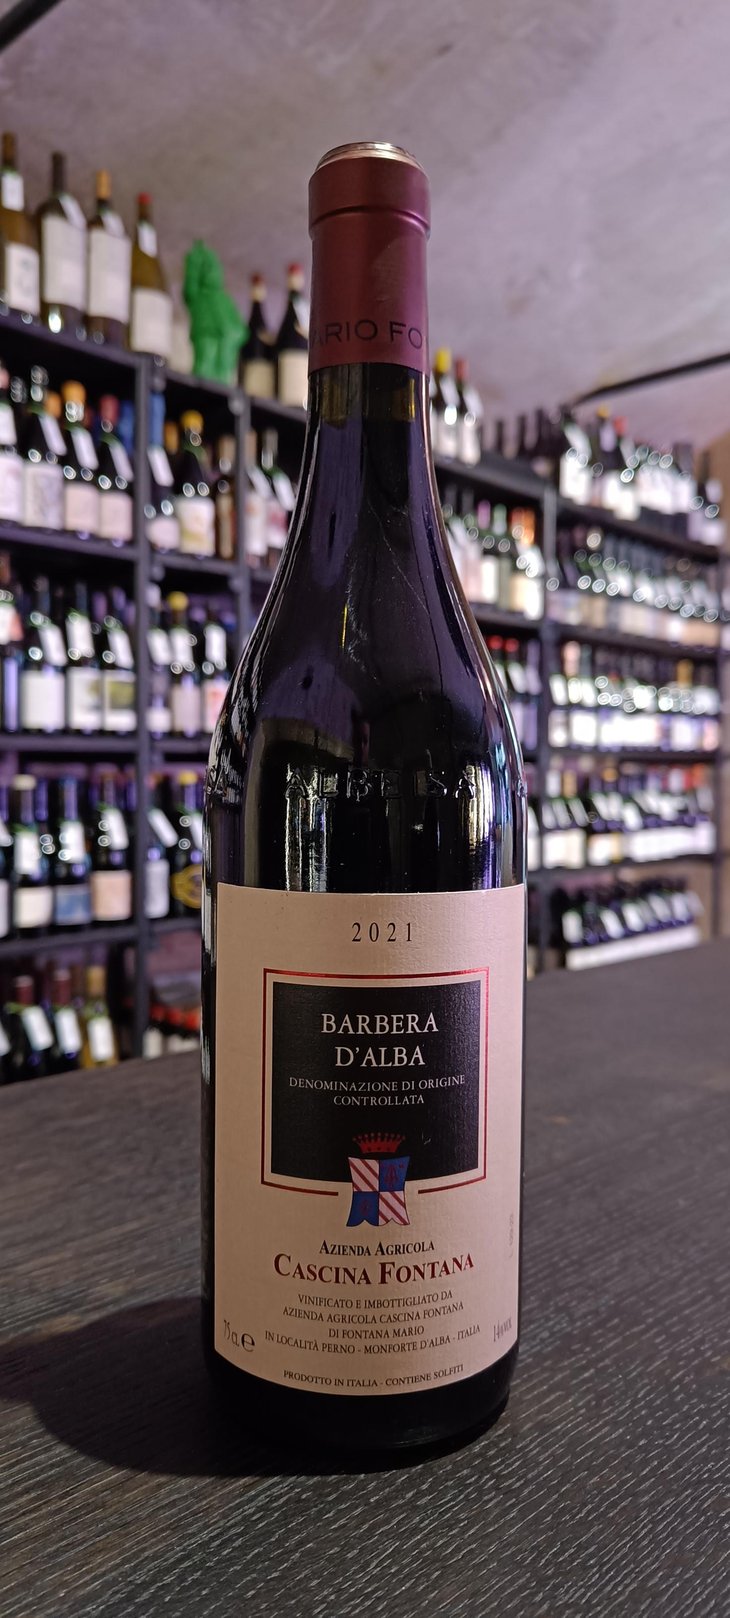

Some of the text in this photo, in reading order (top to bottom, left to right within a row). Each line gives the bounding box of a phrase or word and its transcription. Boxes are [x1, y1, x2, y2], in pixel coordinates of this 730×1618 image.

[352, 922, 414, 942] 2021
[321, 1012, 439, 1035] BARBERA
[335, 1045, 426, 1068] D’ALBA
[289, 1074, 466, 1092] DENOMINAZIONE DI ORIGINE
[333, 1094, 425, 1106] CONTROLLATA
[319, 1239, 435, 1257] AZIENDA AGRICOLA
[273, 1252, 474, 1285] CASCINA FONTANA
[298, 1290, 453, 1309] VINIFICATO E IMBOTTIGLIATO DA
[283, 1301, 464, 1324] AZIENDA AGRICOLA CASCINA FONTANA
[264, 1330, 276, 1341] IN
[276, 1334, 320, 1352] LOCALITÀ
[322, 1344, 356, 1354] PERNO
[364, 1343, 418, 1354] MONFORTE
[457, 1324, 481, 1341] ITALIA
[328, 1325, 424, 1340] DI FONTANA MARIO
[283, 1369, 331, 1386] PRODOTTO
[334, 1378, 344, 1386] IN
[346, 1378, 378, 1387] ITALIA
[386, 1373, 432, 1387] CONTIENE
[434, 1364, 464, 1378] SOLFITI
